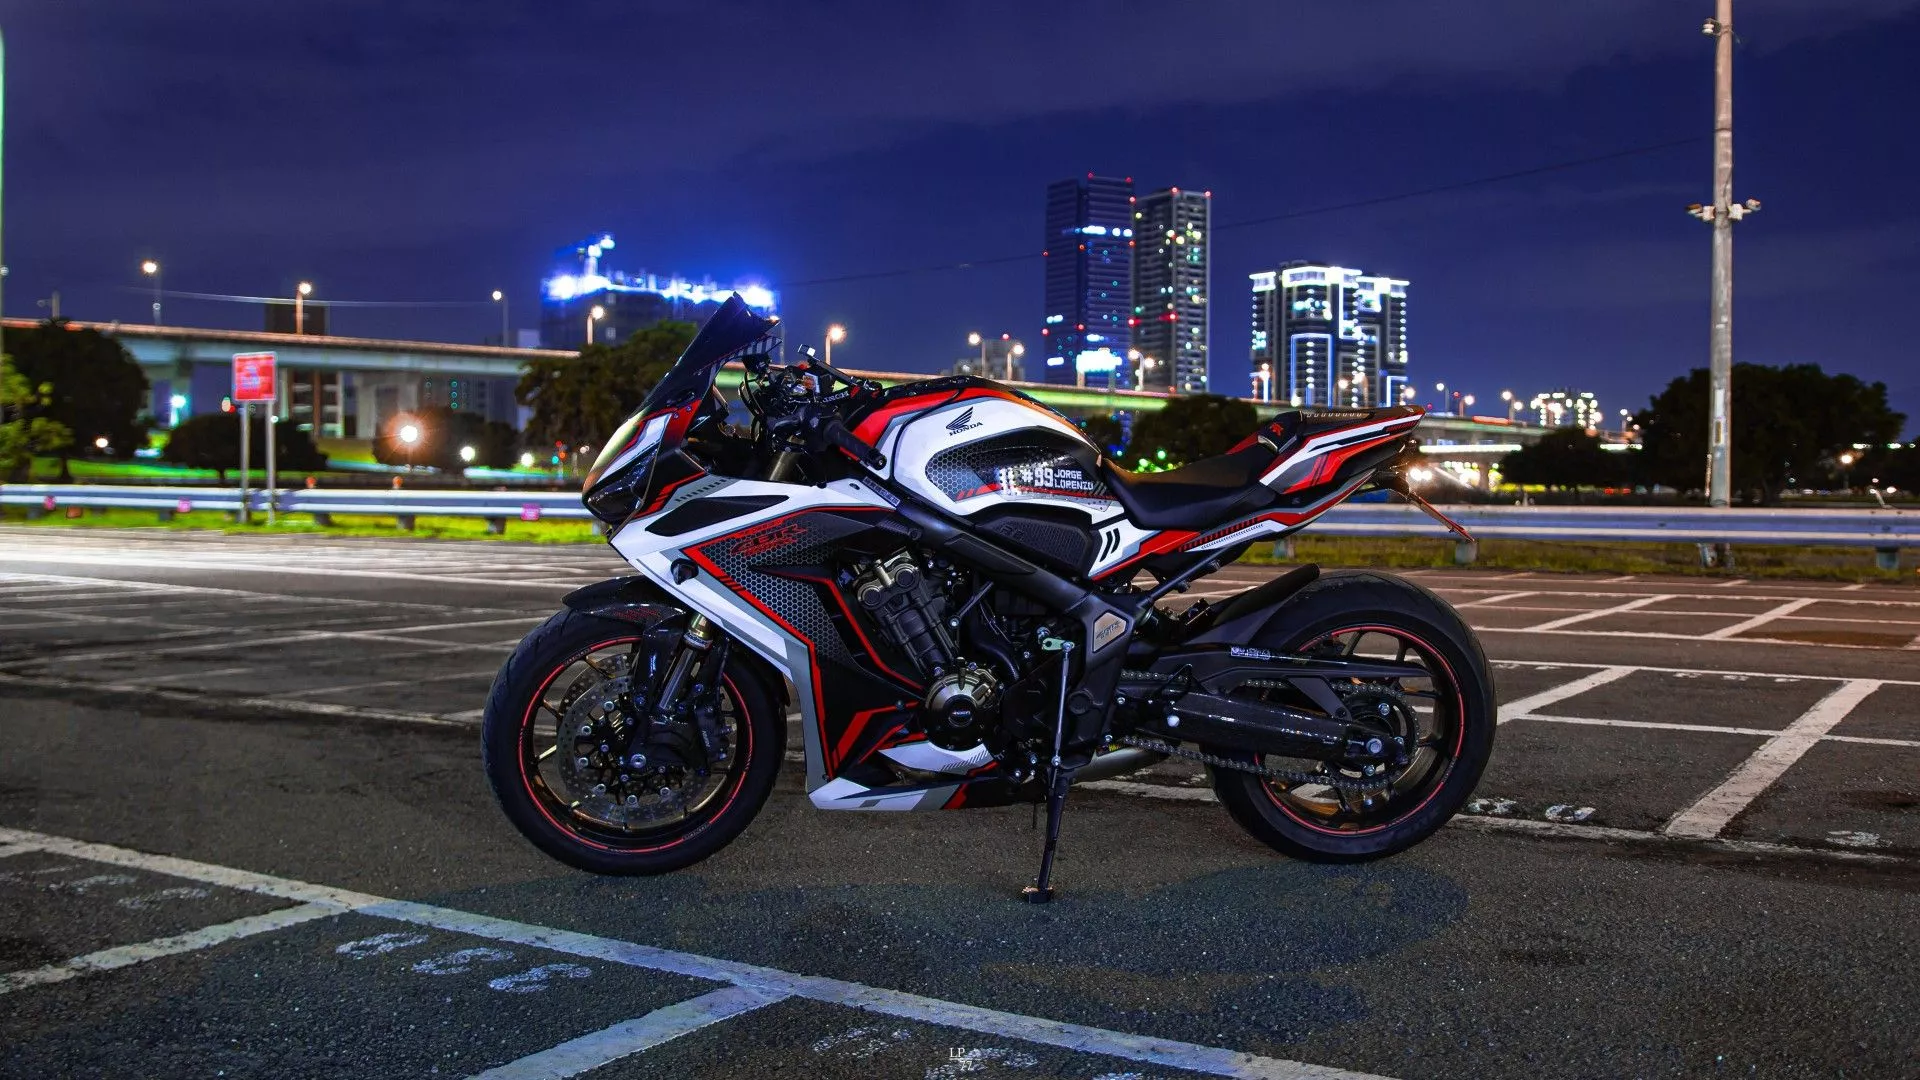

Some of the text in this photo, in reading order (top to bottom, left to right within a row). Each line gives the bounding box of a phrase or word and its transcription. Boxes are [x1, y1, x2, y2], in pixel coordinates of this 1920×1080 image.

[949, 421, 983, 436] HONDA
[1054, 469, 1082, 480] JORGE
[1054, 479, 1094, 490] LORENZO
